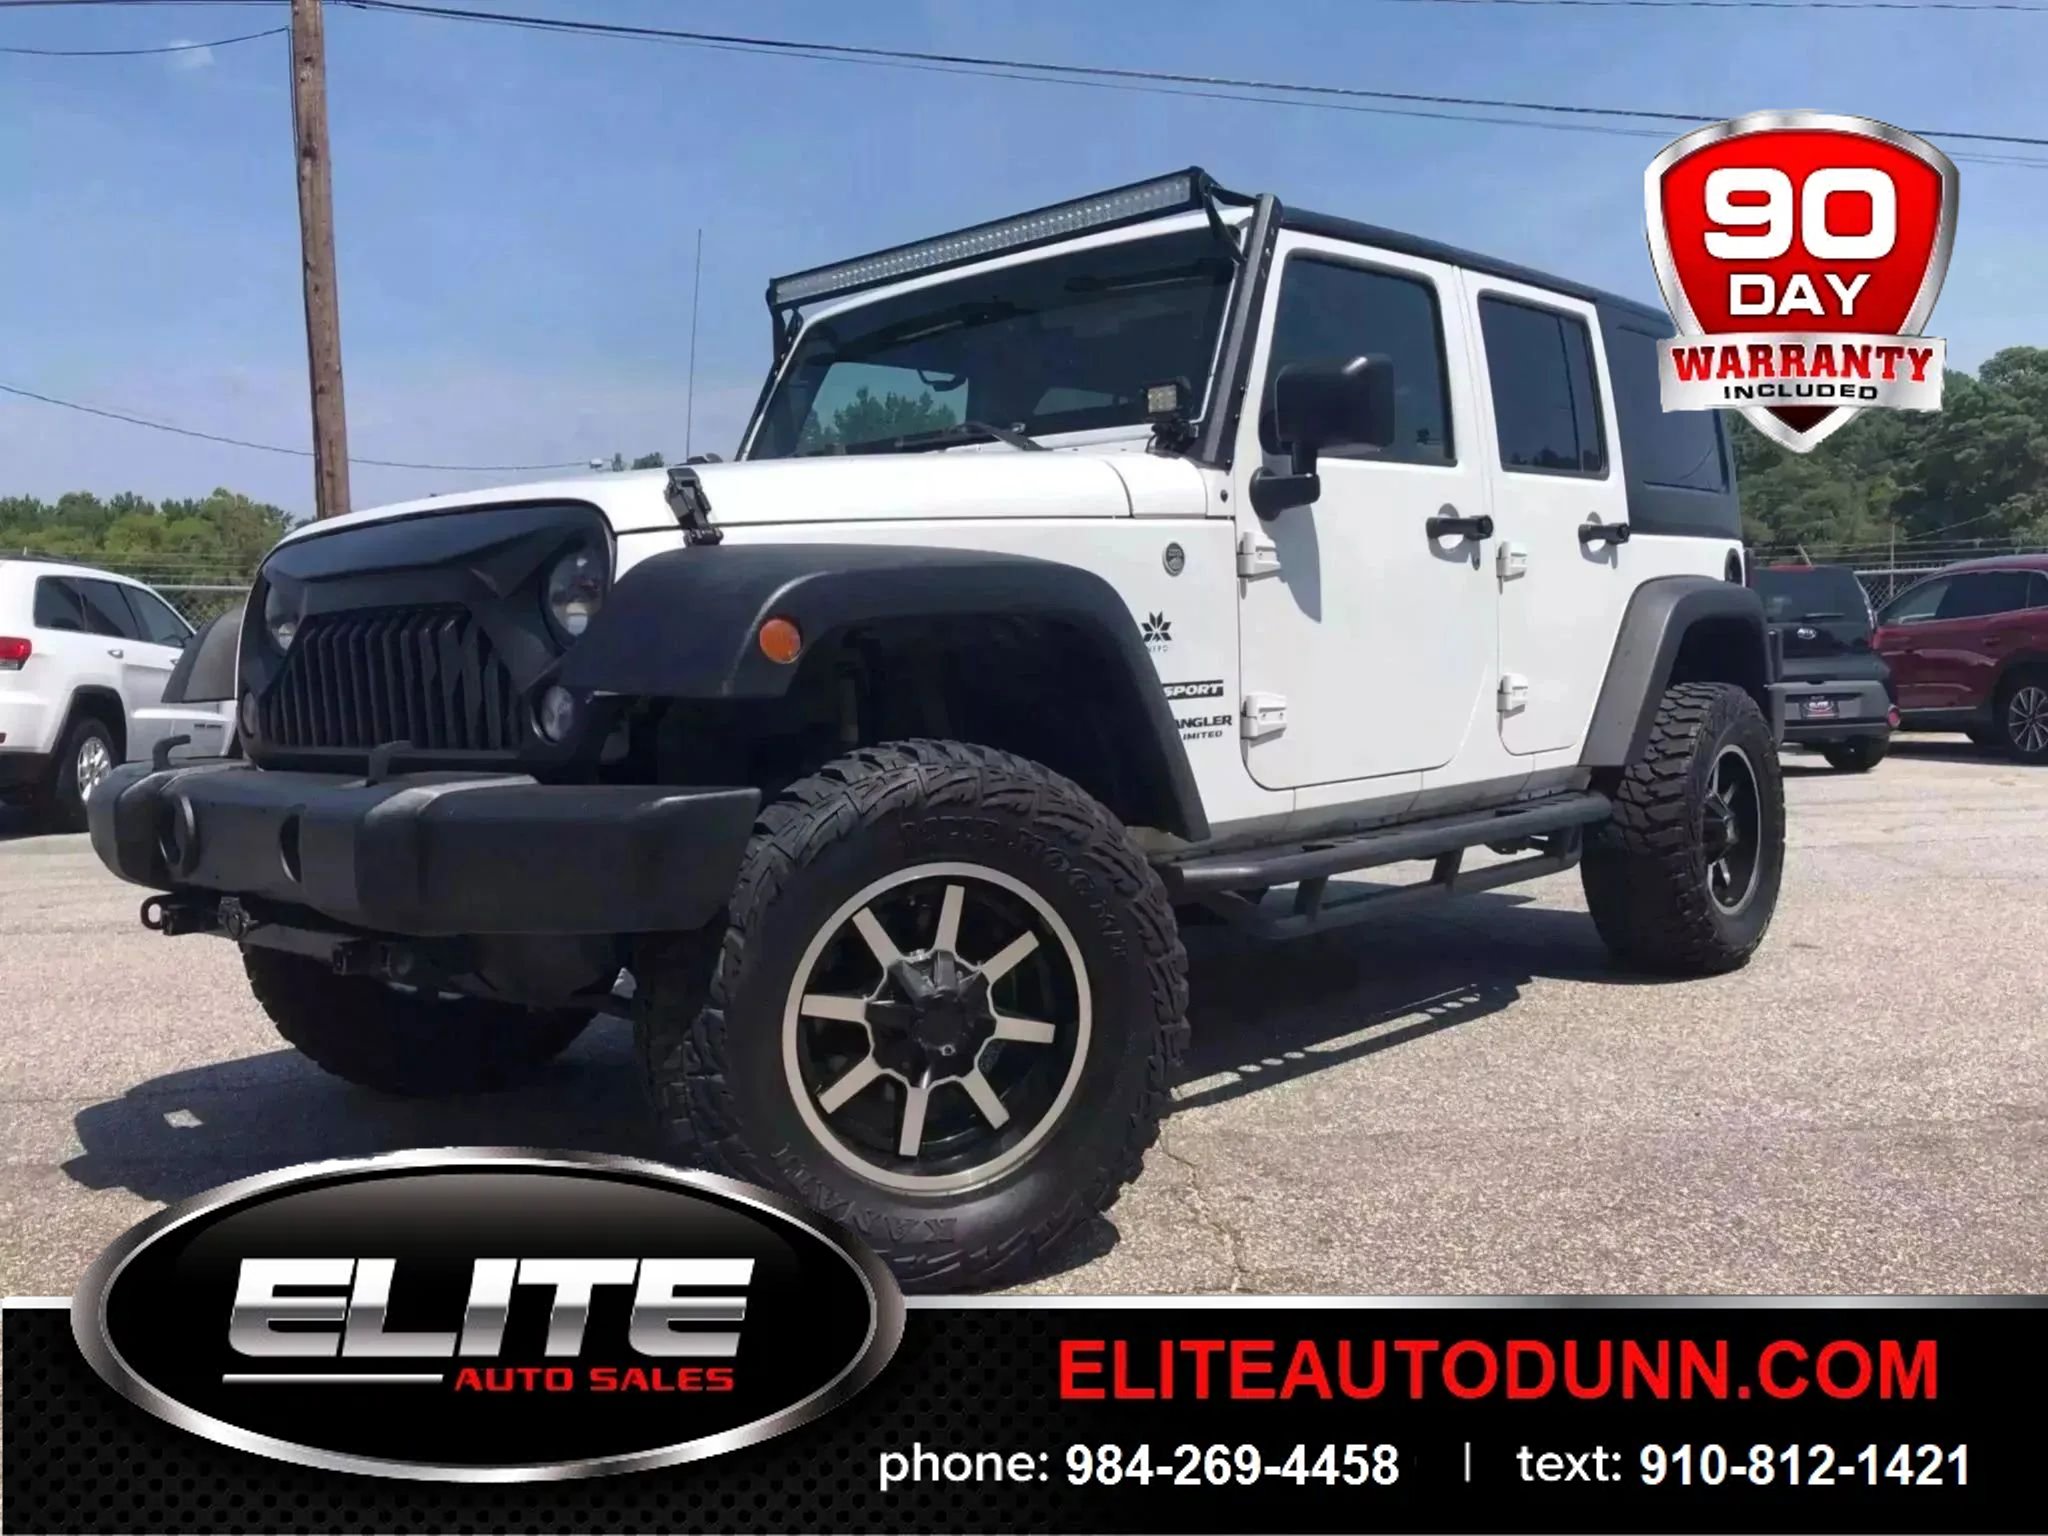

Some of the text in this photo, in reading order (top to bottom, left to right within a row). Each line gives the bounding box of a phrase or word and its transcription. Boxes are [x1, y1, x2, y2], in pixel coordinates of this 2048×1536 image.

[1163, 683, 1223, 698] SPORT
[1175, 714, 1233, 729] ANGLER
[1182, 730, 1223, 741] IMITED
